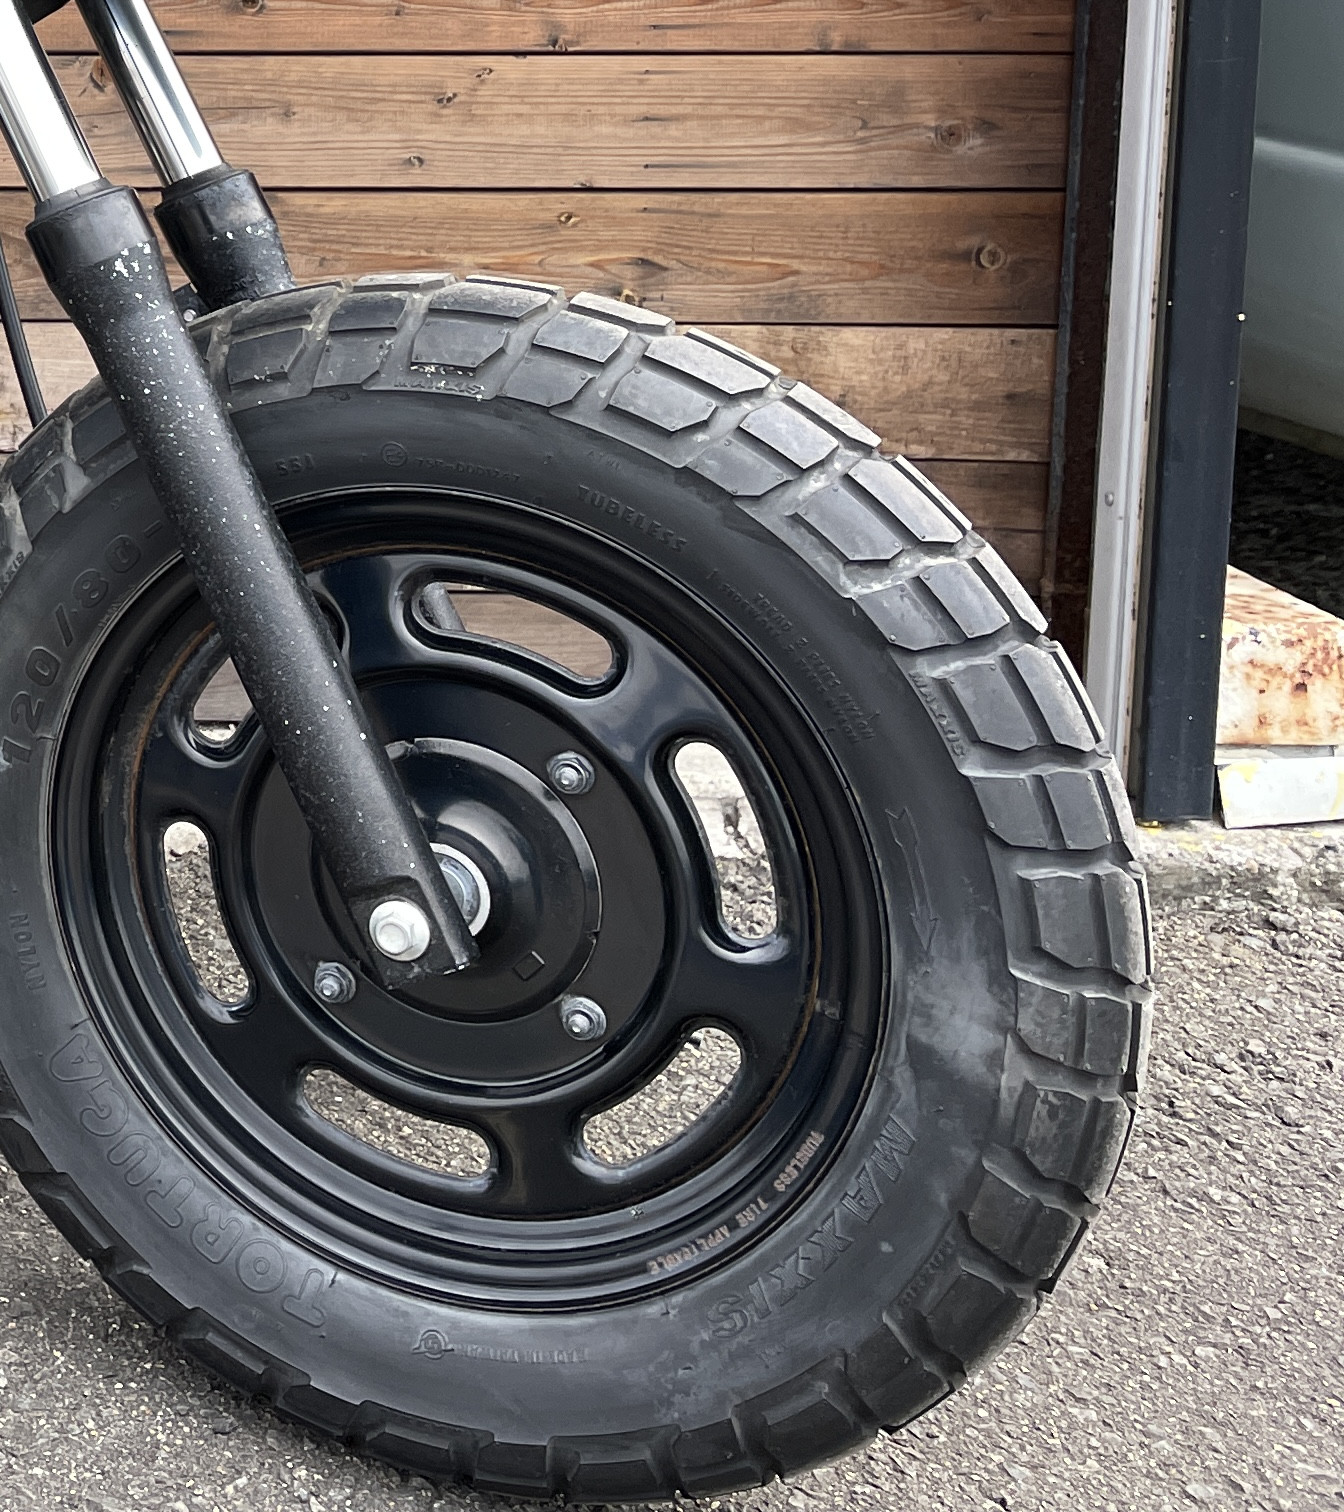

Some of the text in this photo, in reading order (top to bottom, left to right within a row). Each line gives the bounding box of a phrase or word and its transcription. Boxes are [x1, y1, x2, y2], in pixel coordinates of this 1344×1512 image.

[575, 484, 688, 553] TUBELESS
[9, 913, 46, 991] NYLON
[50, 1031, 344, 1327] TORTUGA
[707, 1113, 916, 1342] MAXXIS
